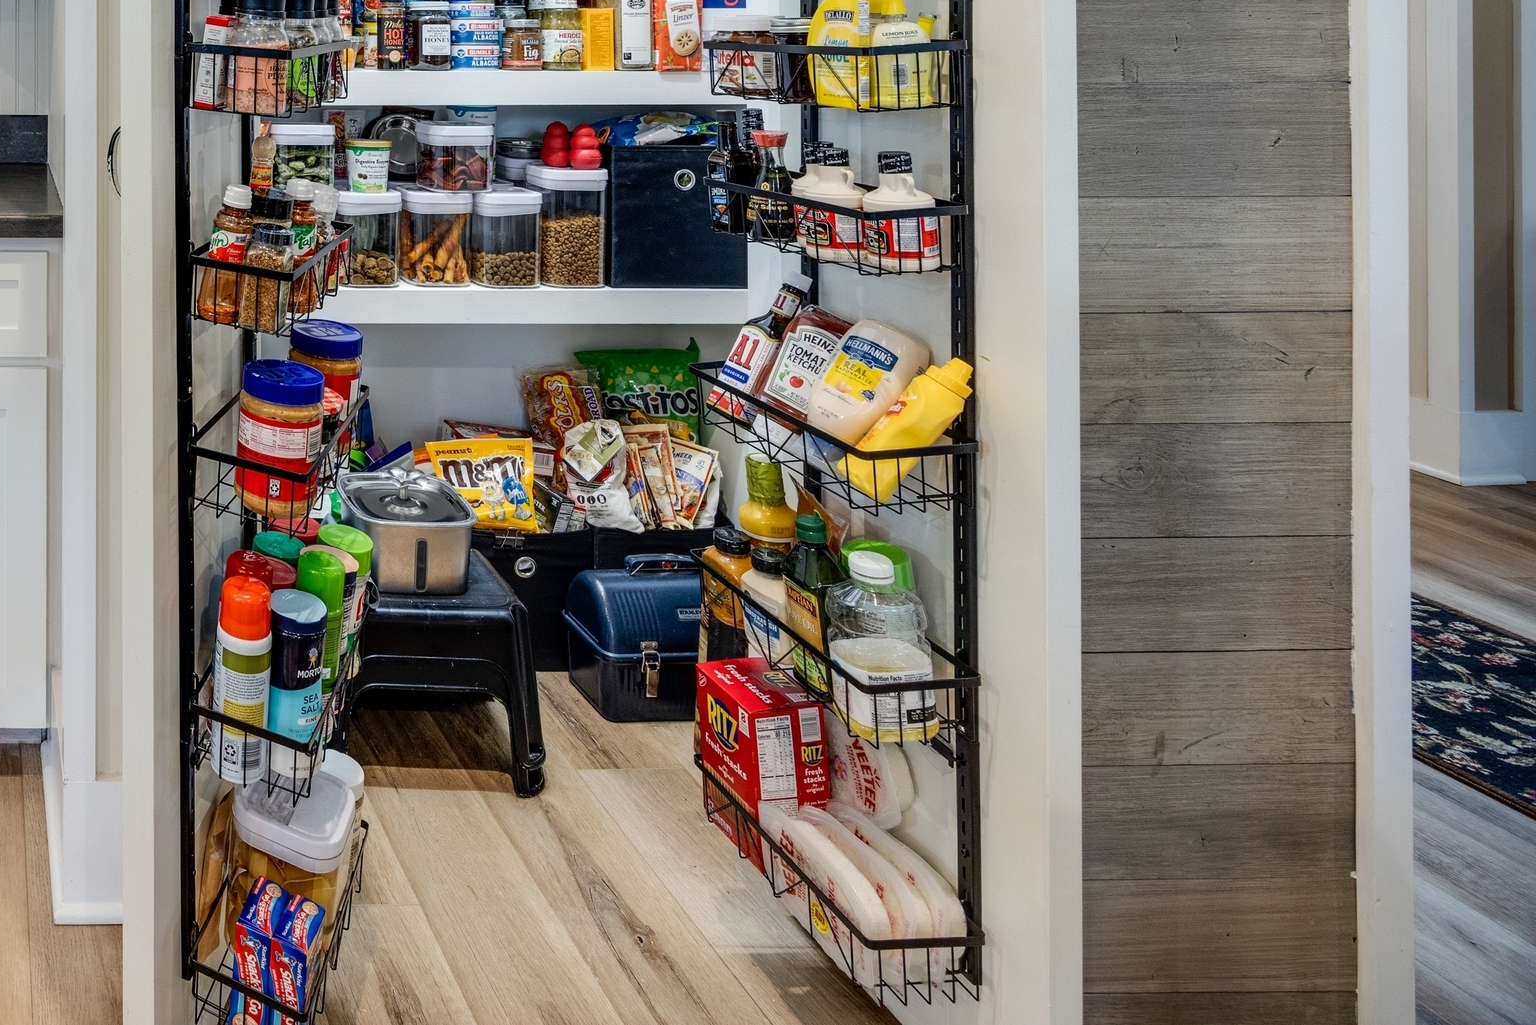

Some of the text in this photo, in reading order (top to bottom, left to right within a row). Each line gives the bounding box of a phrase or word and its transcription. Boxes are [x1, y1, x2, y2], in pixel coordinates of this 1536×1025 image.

[673, 13, 693, 23] Linzer
[825, 11, 851, 20] DELALLO
[384, 29, 404, 39] HOT
[824, 35, 849, 47] Lemon
[524, 45, 539, 59] Fig
[719, 50, 755, 67] utella
[803, 333, 835, 354] HEINZ
[789, 343, 826, 367] TOMAT
[846, 339, 893, 365] HELLMANN'S
[787, 354, 822, 375] KETCHU
[843, 361, 867, 378] REAL
[724, 367, 746, 381] ORIGINAL
[724, 377, 738, 386] SAUCE
[835, 365, 873, 385] MAYONNAISE
[585, 387, 603, 421] BROAD
[435, 447, 472, 456] peanut
[297, 667, 322, 678] MORTO
[713, 669, 734, 685] original
[763, 671, 797, 688] RITZ
[724, 664, 773, 705] fresh stacks
[303, 693, 319, 705] SEA
[301, 702, 320, 715] SALT
[707, 693, 739, 750] RITZ
[705, 731, 748, 781] fresh stacks
[801, 744, 824, 760] RITZ
[804, 767, 823, 775] fresh
[851, 738, 878, 814] VEETEE
[803, 775, 826, 784] stacks
[806, 785, 825, 794] original
[829, 910, 837, 944] STICK
[260, 944, 268, 970] StarKist
[296, 961, 304, 988] StarKist
